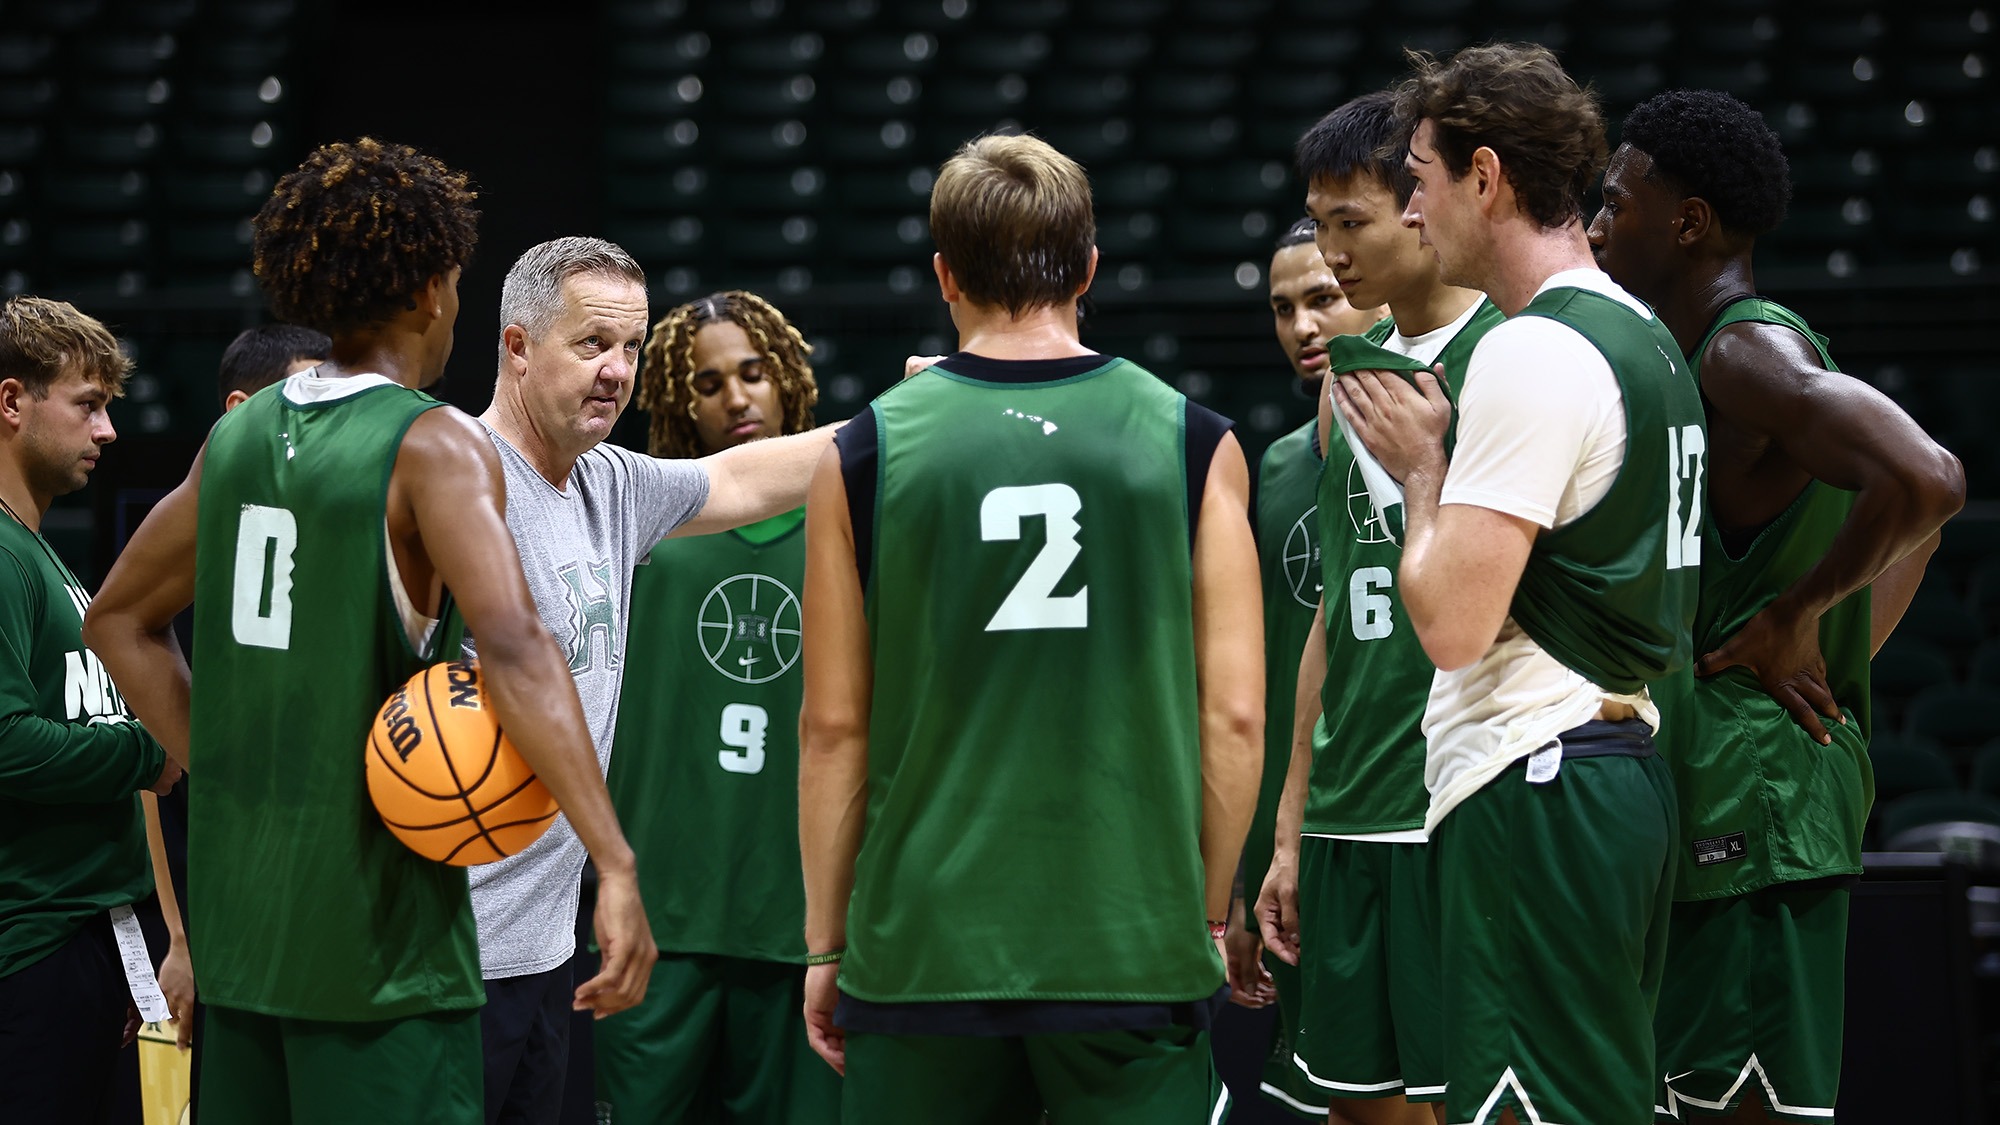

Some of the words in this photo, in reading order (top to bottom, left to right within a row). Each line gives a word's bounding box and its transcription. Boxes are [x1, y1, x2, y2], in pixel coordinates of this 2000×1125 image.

[1666, 424, 1705, 570] 12
[232, 503, 298, 650] 0
[980, 483, 1088, 631] 2
[1349, 566, 1394, 641] 6
[383, 685, 422, 764] Wil
[718, 702, 769, 775] 9
[1730, 840, 1742, 852] XL
